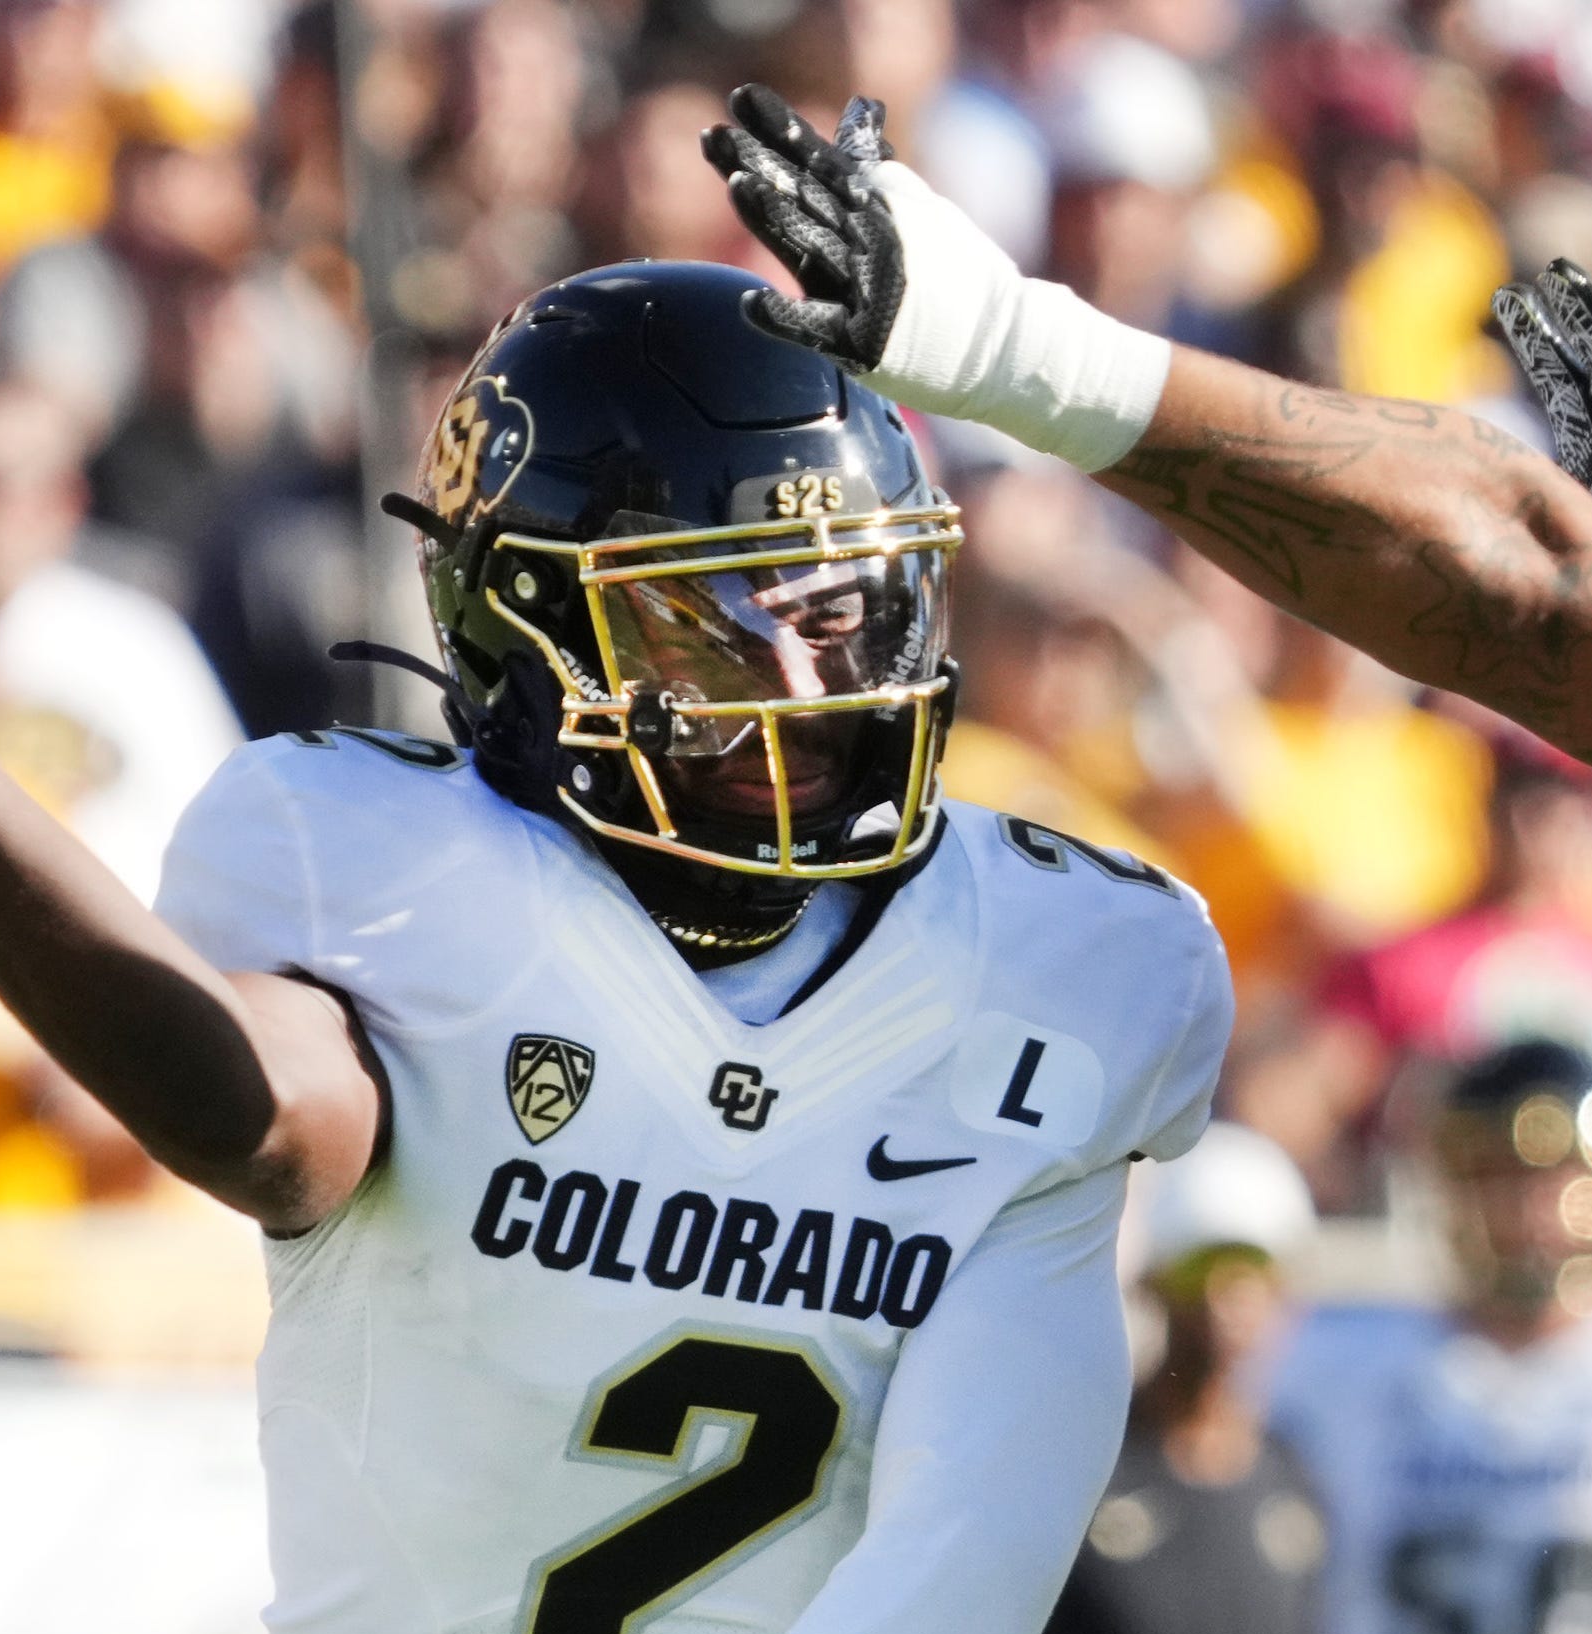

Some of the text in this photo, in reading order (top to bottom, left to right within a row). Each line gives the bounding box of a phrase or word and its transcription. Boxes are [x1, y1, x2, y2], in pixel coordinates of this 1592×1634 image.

[511, 1038, 591, 1108] PAC
[521, 1082, 566, 1123] 12
[997, 1038, 1047, 1128] L
[471, 1158, 953, 1330] COLORADO
